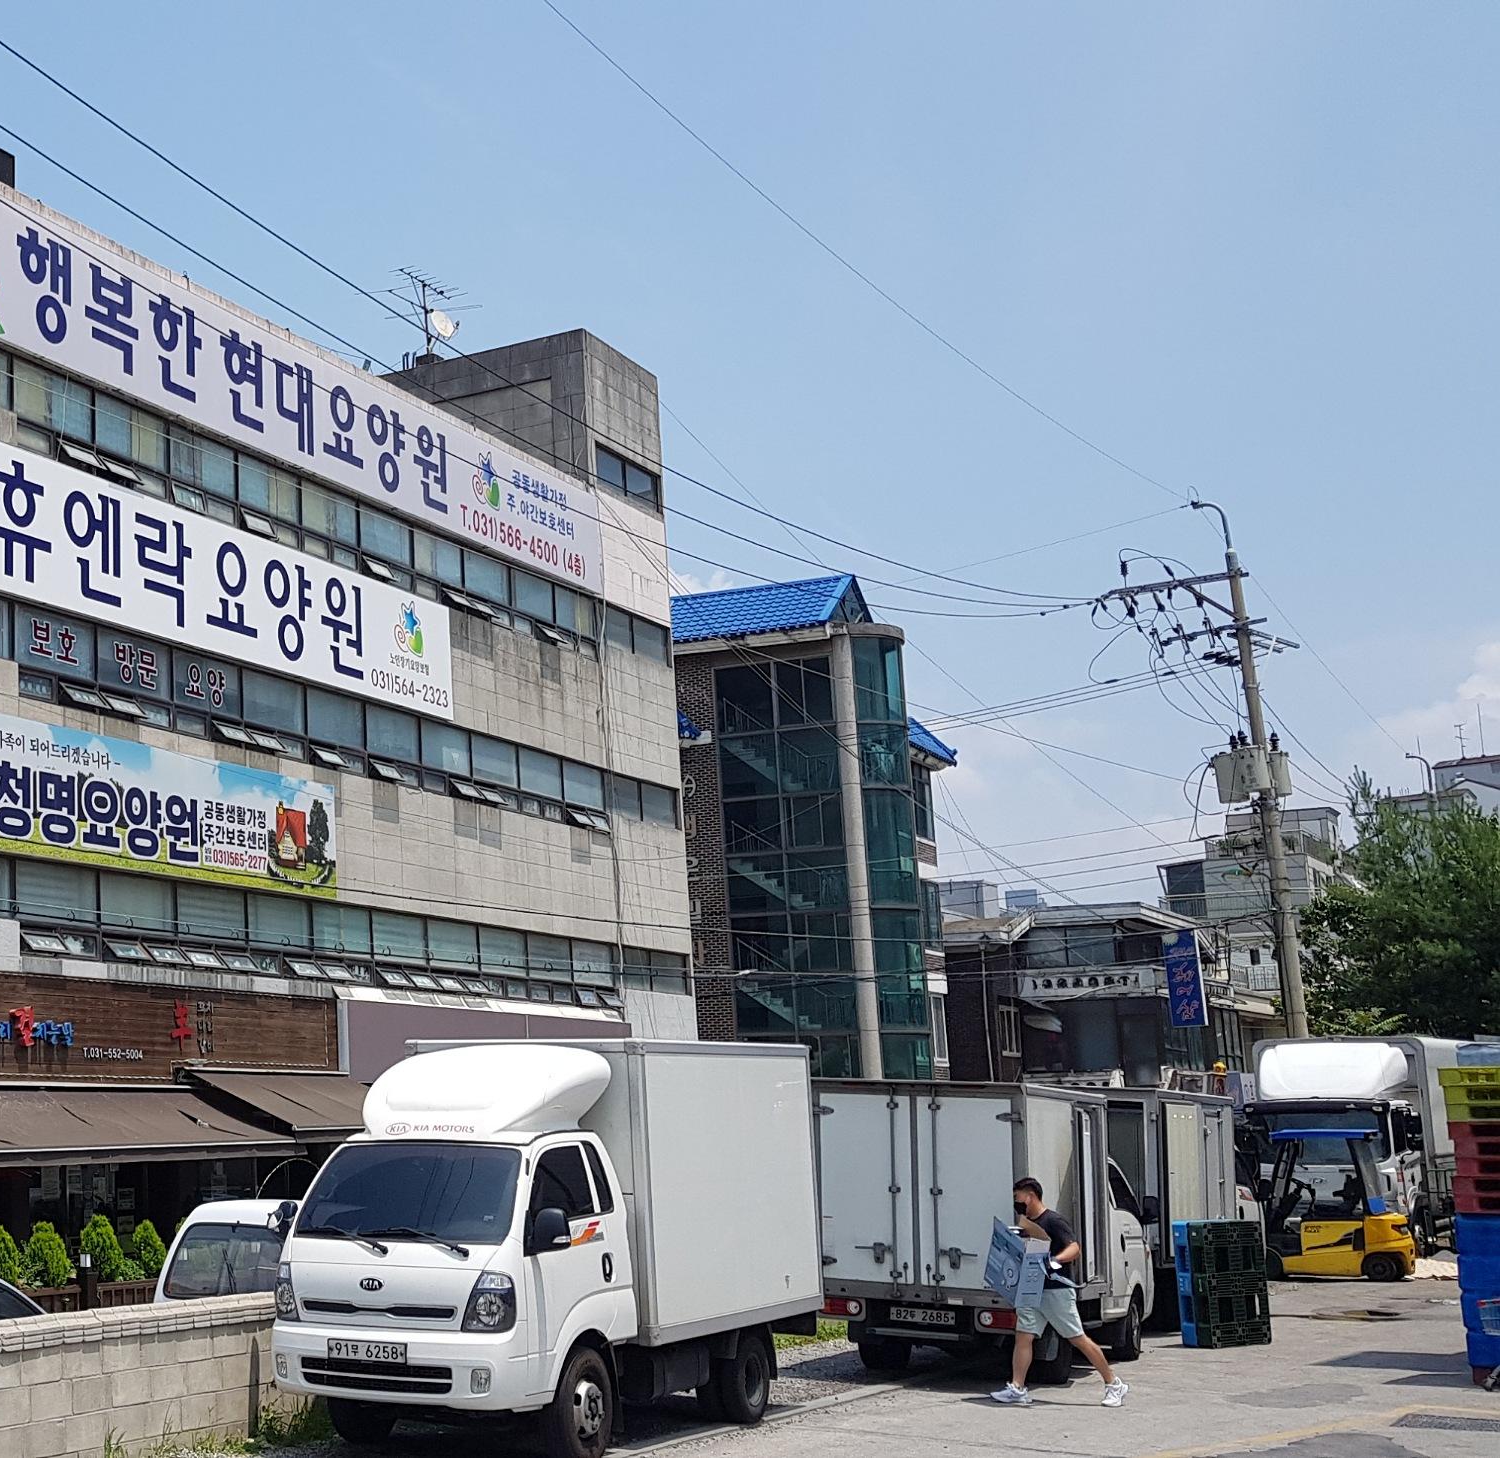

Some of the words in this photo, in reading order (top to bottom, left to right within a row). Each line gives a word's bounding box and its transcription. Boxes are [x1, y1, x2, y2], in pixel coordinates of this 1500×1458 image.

[17, 227, 202, 402] 행복한
[220, 329, 448, 516] 현대요양원
[512, 469, 567, 511] 공동생활가정
[460, 504, 558, 566] T.031)566-4500
[563, 548, 586, 580] (4층)
[207, 541, 365, 680] 요양원
[29, 618, 79, 666] 보호
[114, 641, 158, 690] 방문
[185, 662, 225, 708] 요양
[371, 668, 448, 708] 031)564-2323
[204, 800, 266, 829] 공동생활가정
[213, 849, 267, 871] 031)565-2277
[83, 1047, 143, 1060] T.031-552-5004
[433, 1125, 475, 1133] MOTORS
[365, 1344, 399, 1360] 6258
